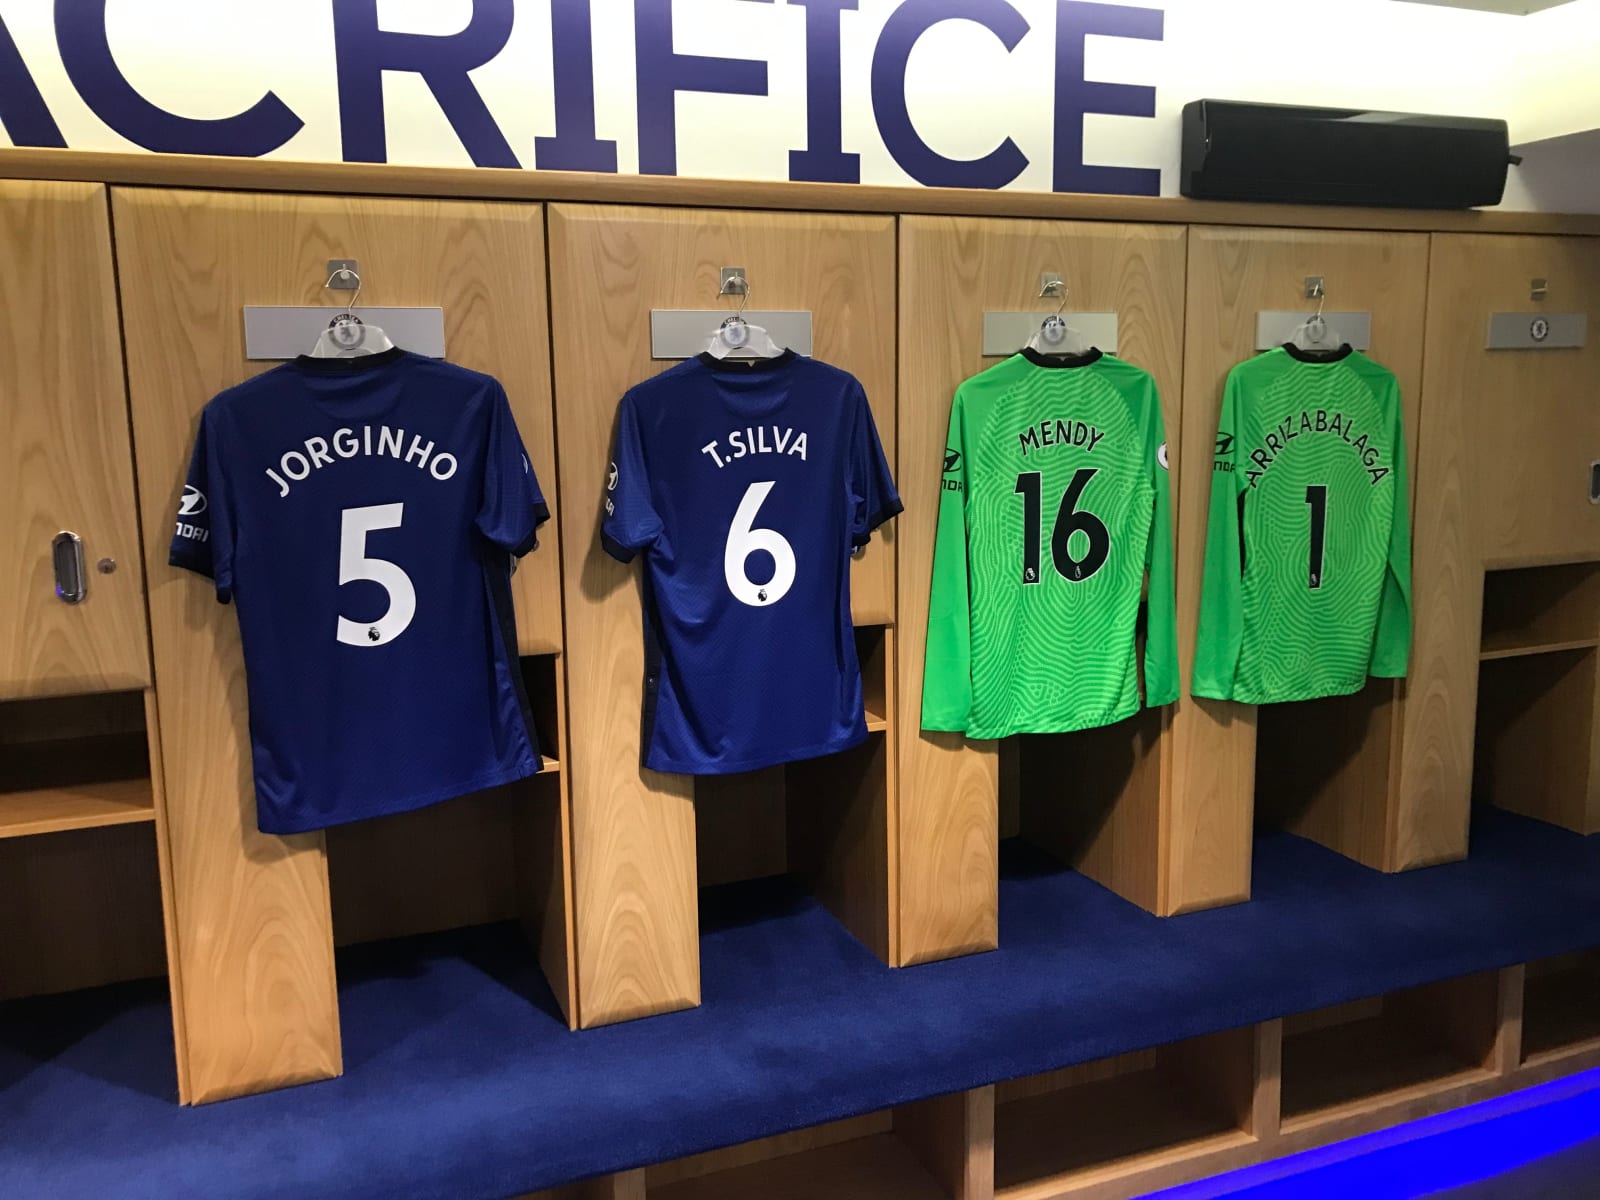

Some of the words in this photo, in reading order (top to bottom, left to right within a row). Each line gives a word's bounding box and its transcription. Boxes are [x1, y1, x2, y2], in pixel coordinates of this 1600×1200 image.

[0, 0, 1164, 196] CRIFICE
[265, 426, 458, 498] JORGINHO
[701, 426, 808, 468] T.SILVA
[1018, 420, 1105, 456] MENDY
[1246, 410, 1390, 489] ARRIZABALAGA
[336, 502, 416, 647] 5
[724, 481, 796, 607] 6
[1014, 468, 1111, 585] 16
[1305, 485, 1327, 589] 1
